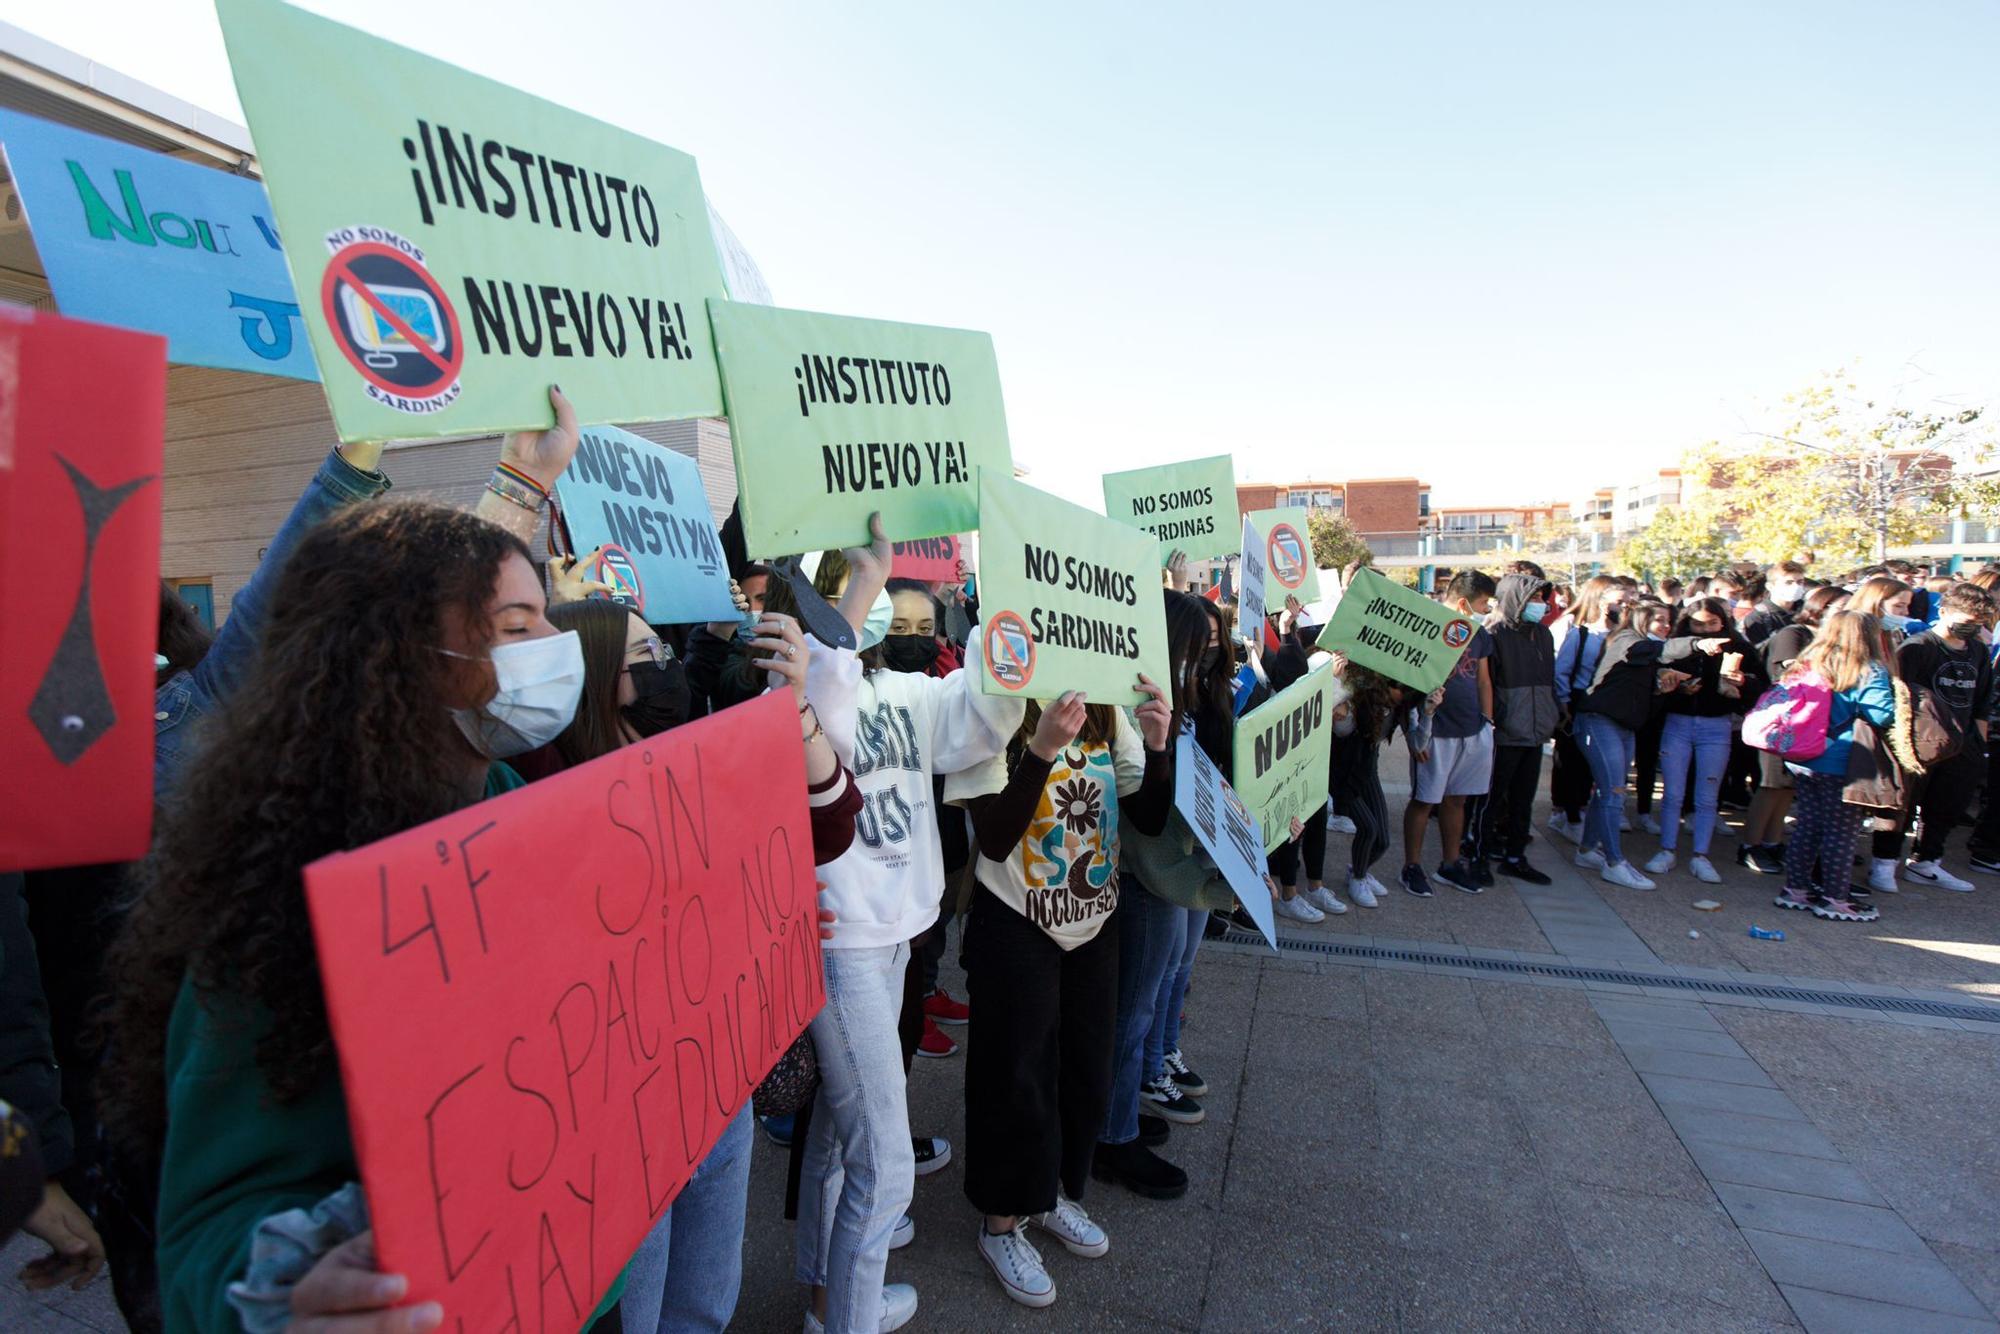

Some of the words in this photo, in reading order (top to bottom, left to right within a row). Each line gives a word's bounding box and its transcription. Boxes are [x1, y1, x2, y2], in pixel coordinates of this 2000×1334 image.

[402, 118, 660, 248] ¡INSTITUTO
[327, 228, 355, 249] NO
[358, 226, 425, 262] SOMOS
[462, 275, 627, 359] NUEVO
[628, 296, 693, 360] YA!
[366, 384, 461, 412] SARDINAS
[794, 353, 951, 417] ¡INSTITUTO
[822, 442, 922, 494] NUEVO
[925, 441, 969, 485] YA!
[1132, 495, 1156, 516] NO
[1158, 486, 1213, 512] SOMOS
[602, 500, 687, 560] INSTI
[1140, 515, 1215, 542] RDINAS
[1024, 543, 1060, 586] NO
[1064, 556, 1137, 607] SOMOS
[1030, 607, 1140, 660] SARDINAS
[1364, 596, 1441, 641] ¡INSTITUTO
[1356, 624, 1405, 658] NUEVO
[1403, 645, 1429, 669] YA!
[1254, 688, 1323, 779] NUEVO
[740, 825, 796, 955] NO
